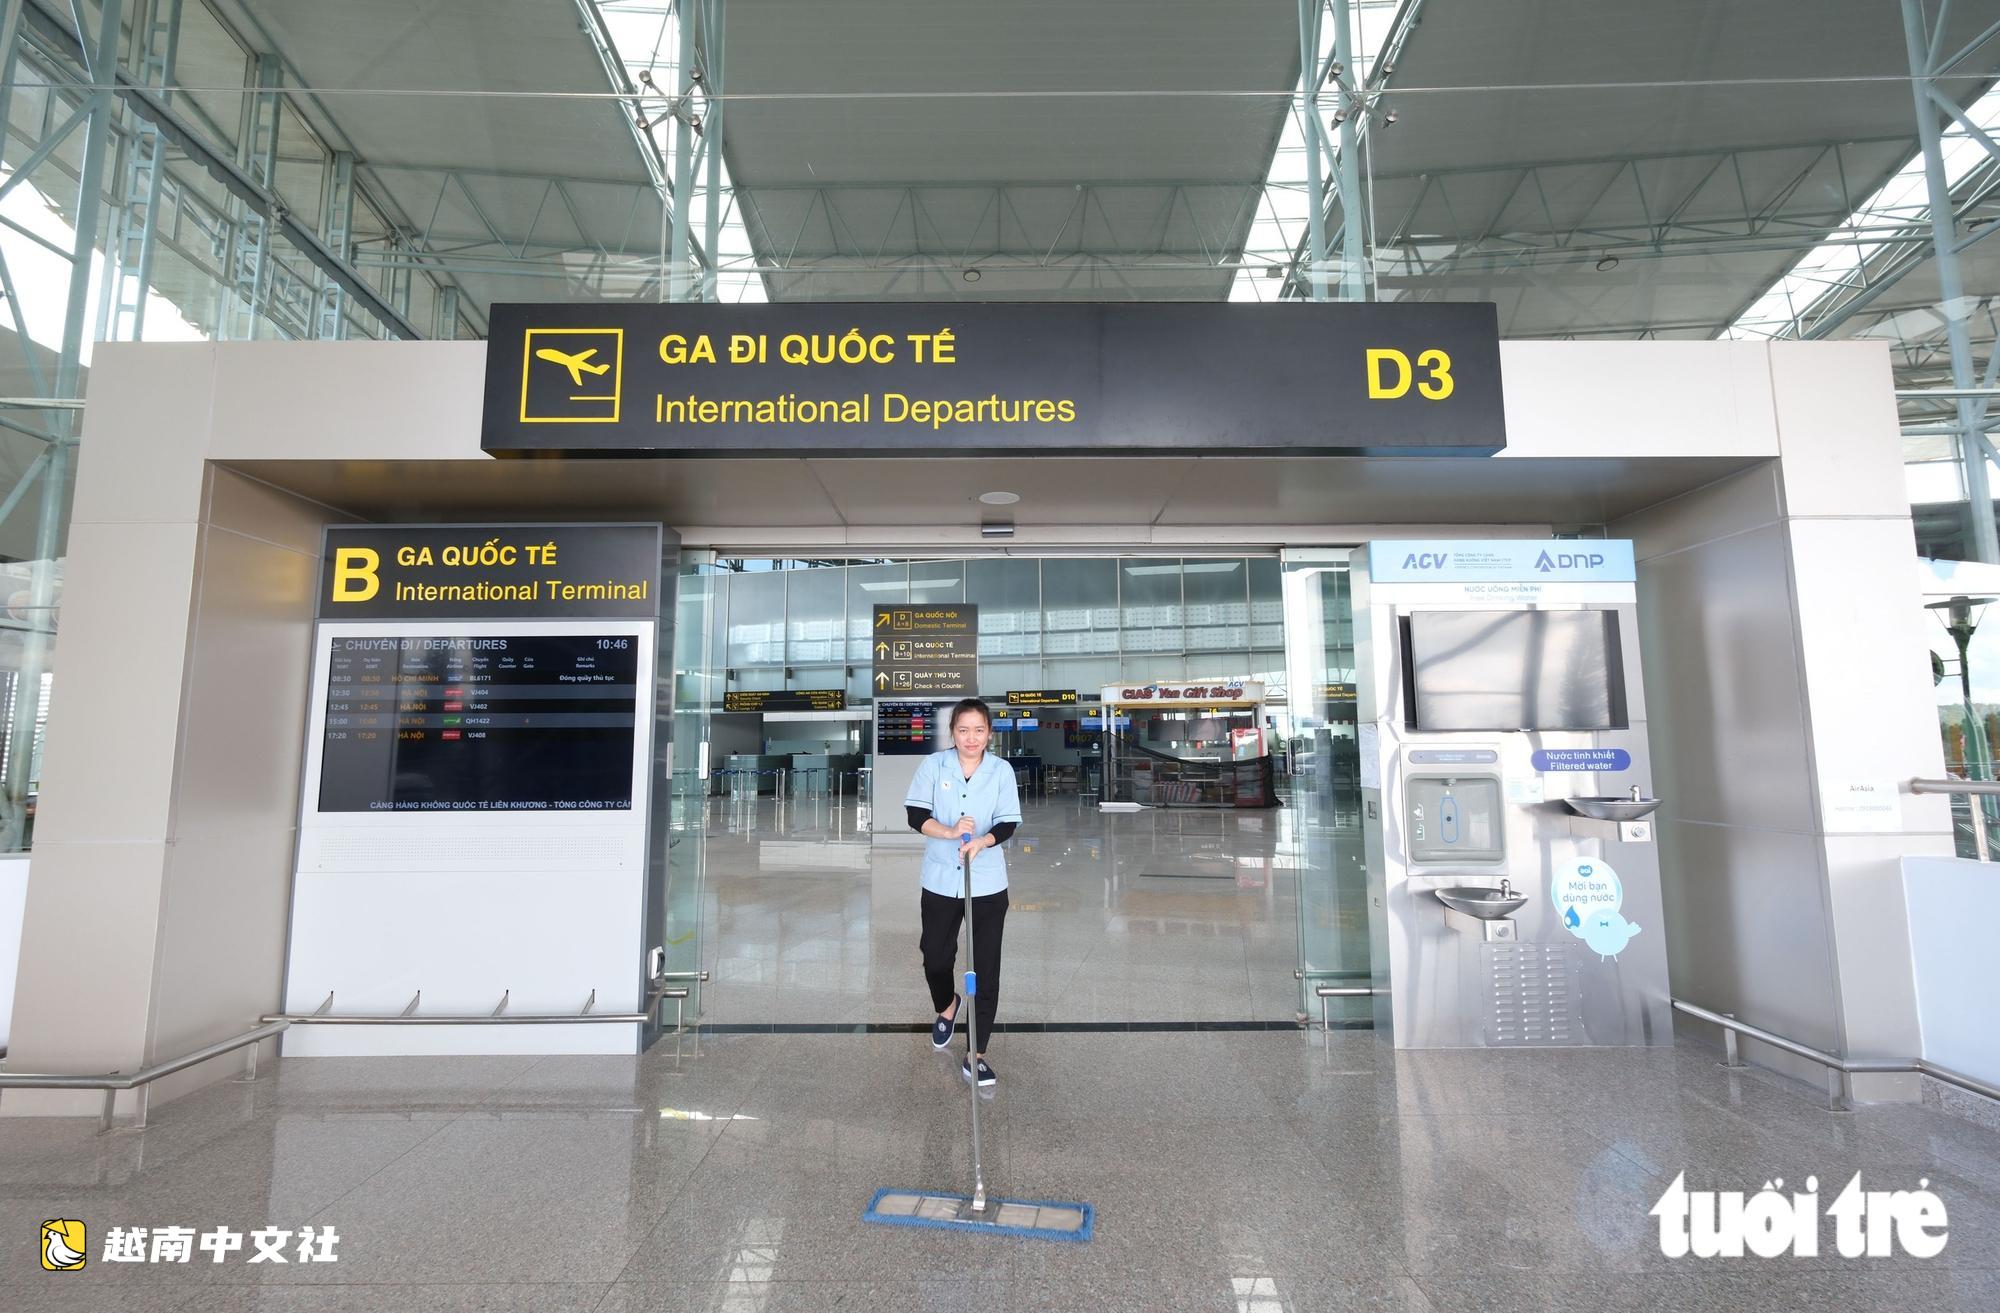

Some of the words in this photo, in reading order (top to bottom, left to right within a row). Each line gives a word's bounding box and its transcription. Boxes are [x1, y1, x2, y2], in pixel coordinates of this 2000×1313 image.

[660, 334, 717, 364] GA
[729, 334, 767, 364] ĐI
[779, 327, 895, 367] QUỐC
[907, 327, 956, 364] TẾ
[1365, 348, 1455, 401] D3
[655, 393, 870, 423] International
[883, 393, 1076, 430] Departures
[396, 545, 434, 567] GA
[442, 538, 517, 567] QUỐC
[525, 541, 557, 565] TẾ
[1401, 553, 1448, 570] ACV
[332, 547, 381, 602] B
[395, 581, 538, 601] International
[546, 580, 648, 600] Terminal
[925, 611, 944, 619] QUỐC
[945, 611, 958, 619] NỘI
[400, 639, 413, 650] ĐI
[423, 639, 508, 650] DEPARTURES
[596, 639, 628, 650] 10:46
[925, 641, 944, 649] QUỐC
[559, 674, 576, 682] Đóng
[899, 673, 906, 681] C
[948, 672, 961, 680] TỤC
[1183, 686, 1209, 698] Gift
[1209, 685, 1244, 700] Shop
[1546, 751, 1573, 760] Nước
[1574, 751, 1591, 760] tinh
[1592, 749, 1615, 760] khiết
[1550, 762, 1585, 770] Filtered
[1849, 784, 1875, 793] AirAsia
[395, 799, 419, 809] HÀNG
[421, 799, 451, 809] KHÔNG
[452, 799, 476, 809] QUỐC
[478, 799, 489, 809] TẾ
[490, 799, 508, 809] LIÊN
[510, 799, 547, 809] KHƯƠNG
[554, 799, 577, 809] TỔNG
[578, 799, 602, 808] CÔNG
[604, 800, 614, 808] TY
[1568, 880, 1586, 890] Mời
[1589, 881, 1607, 892] bạn
[1562, 893, 1588, 904] dùng
[1590, 893, 1615, 902] nước
